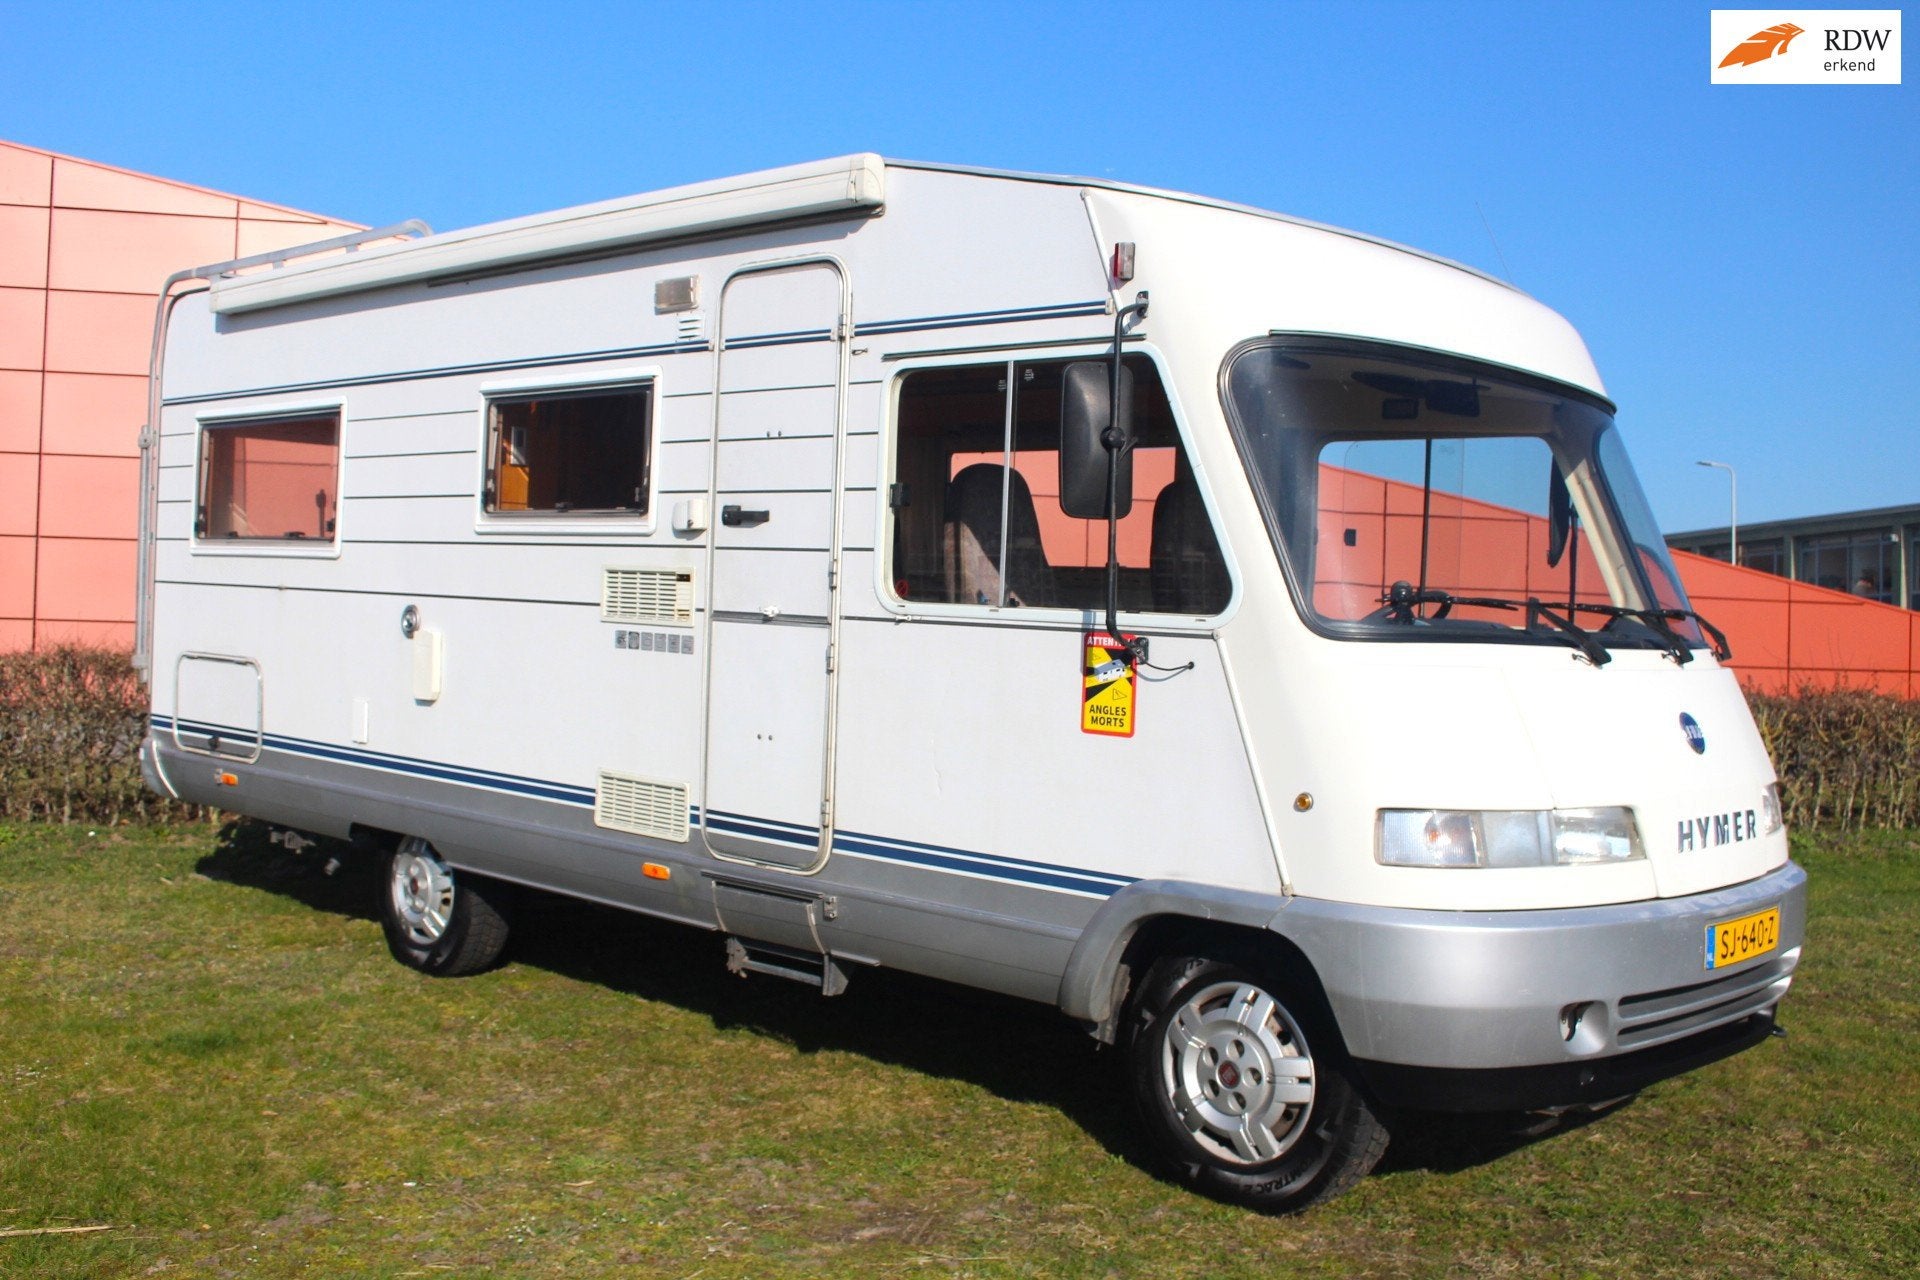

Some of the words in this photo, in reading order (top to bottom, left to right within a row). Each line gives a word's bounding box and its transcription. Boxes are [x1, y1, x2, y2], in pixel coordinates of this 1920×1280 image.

[1089, 705, 1126, 716] ANGLES
[1091, 716, 1125, 727] MORTS
[1677, 809, 1756, 854] HYMER
